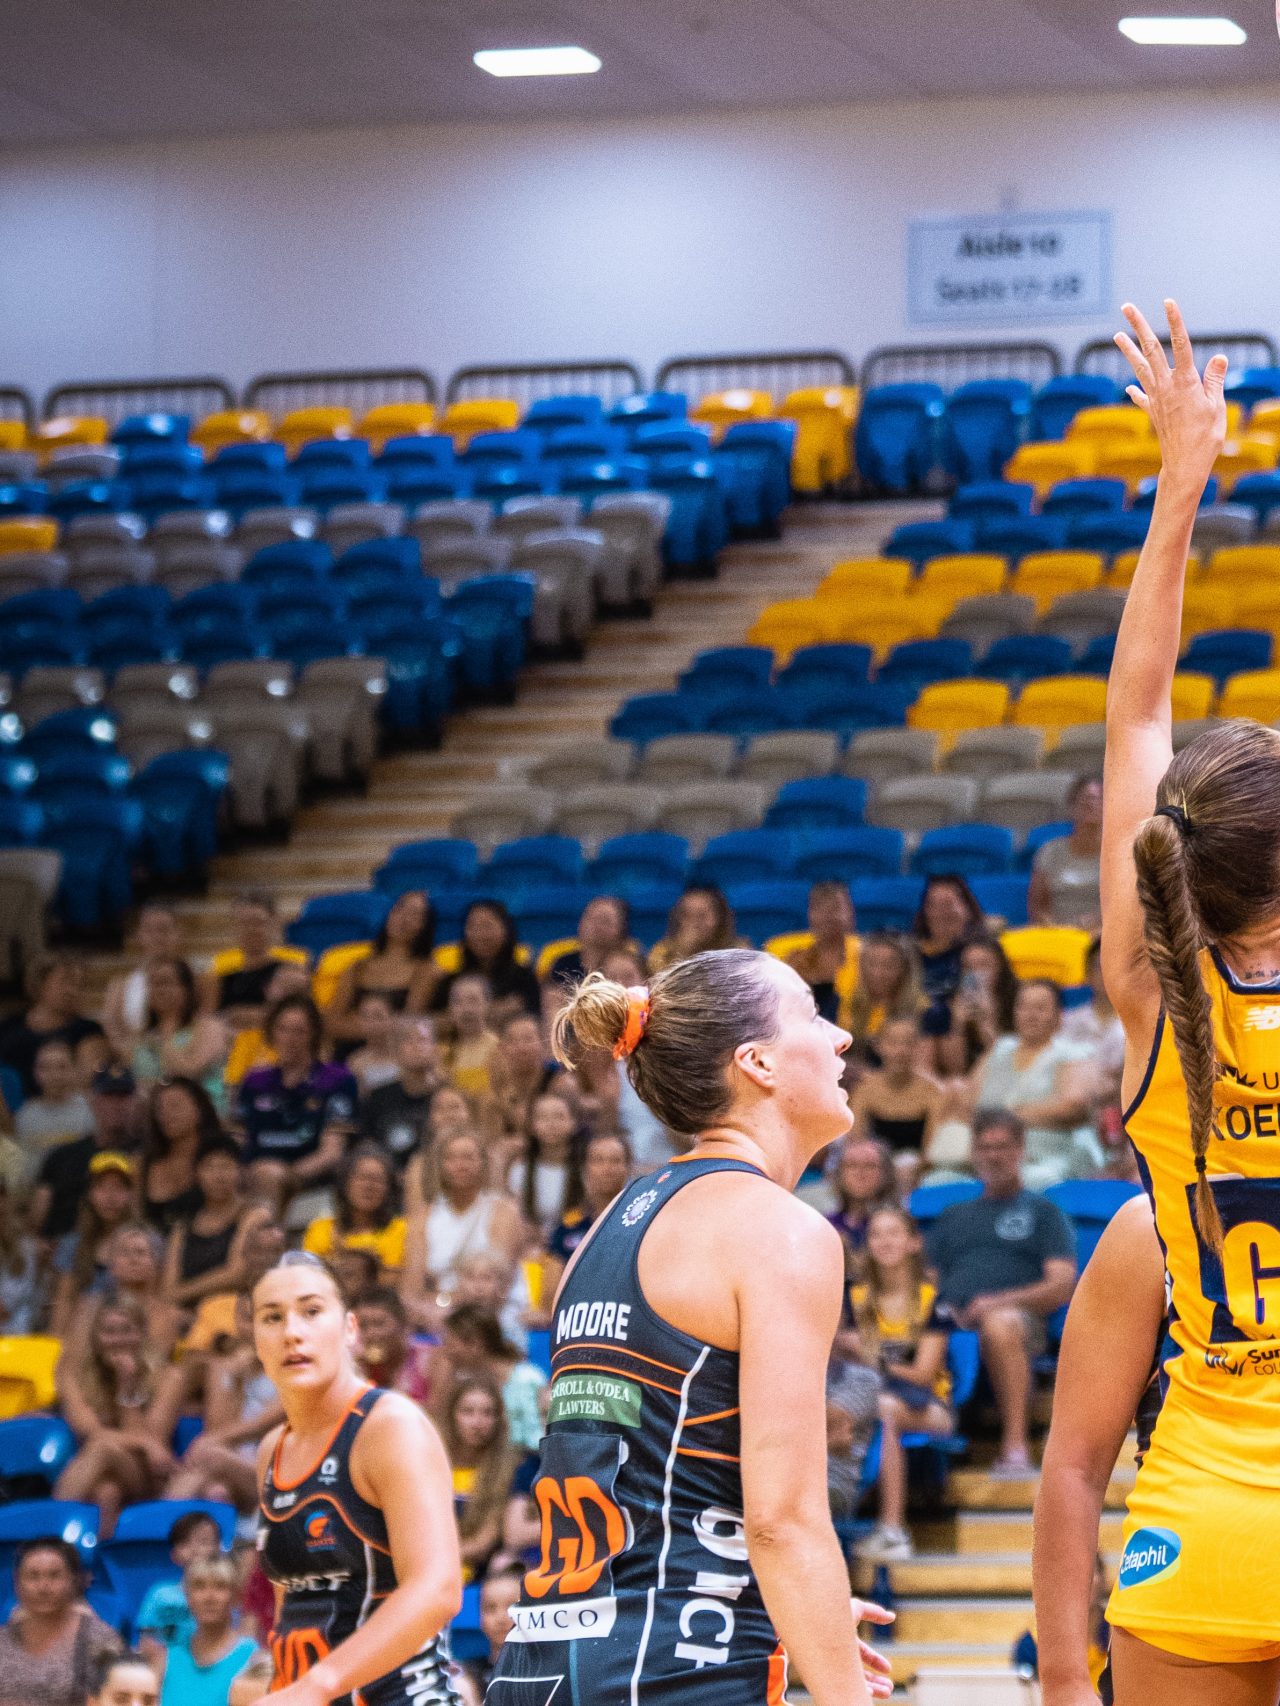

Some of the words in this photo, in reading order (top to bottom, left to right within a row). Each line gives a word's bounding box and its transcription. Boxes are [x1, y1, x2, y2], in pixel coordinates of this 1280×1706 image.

[956, 231, 1021, 258] Aisle
[556, 1301, 632, 1345] MOORE
[552, 1381, 585, 1399] RROLL
[558, 1400, 606, 1416] LAWYERS
[524, 1476, 626, 1598] GD
